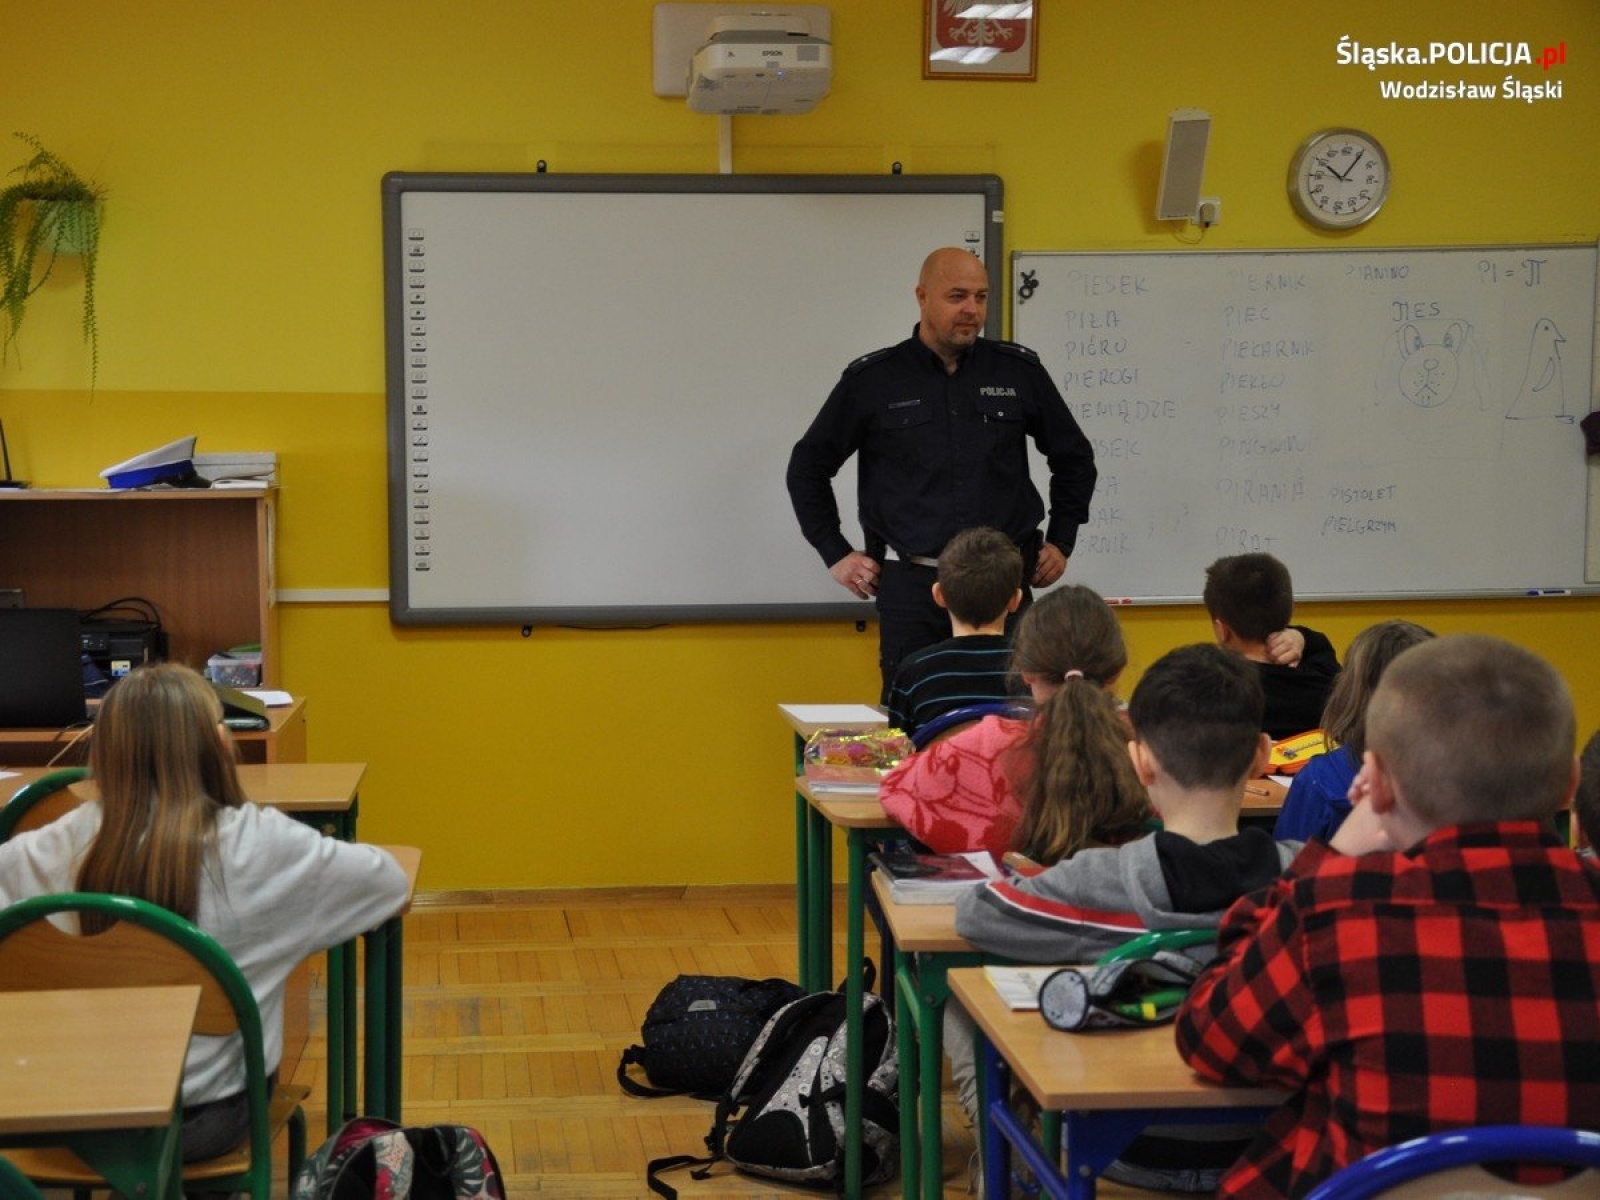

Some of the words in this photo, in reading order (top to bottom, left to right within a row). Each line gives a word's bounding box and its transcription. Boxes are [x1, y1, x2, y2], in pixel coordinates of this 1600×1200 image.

[1067, 269, 1150, 296] PIESEK
[1224, 304, 1271, 327] PIEC
[1063, 367, 1139, 391] PIEROGI
[980, 387, 1017, 397] POLICJA
[1327, 484, 1397, 504] PISTOLET
